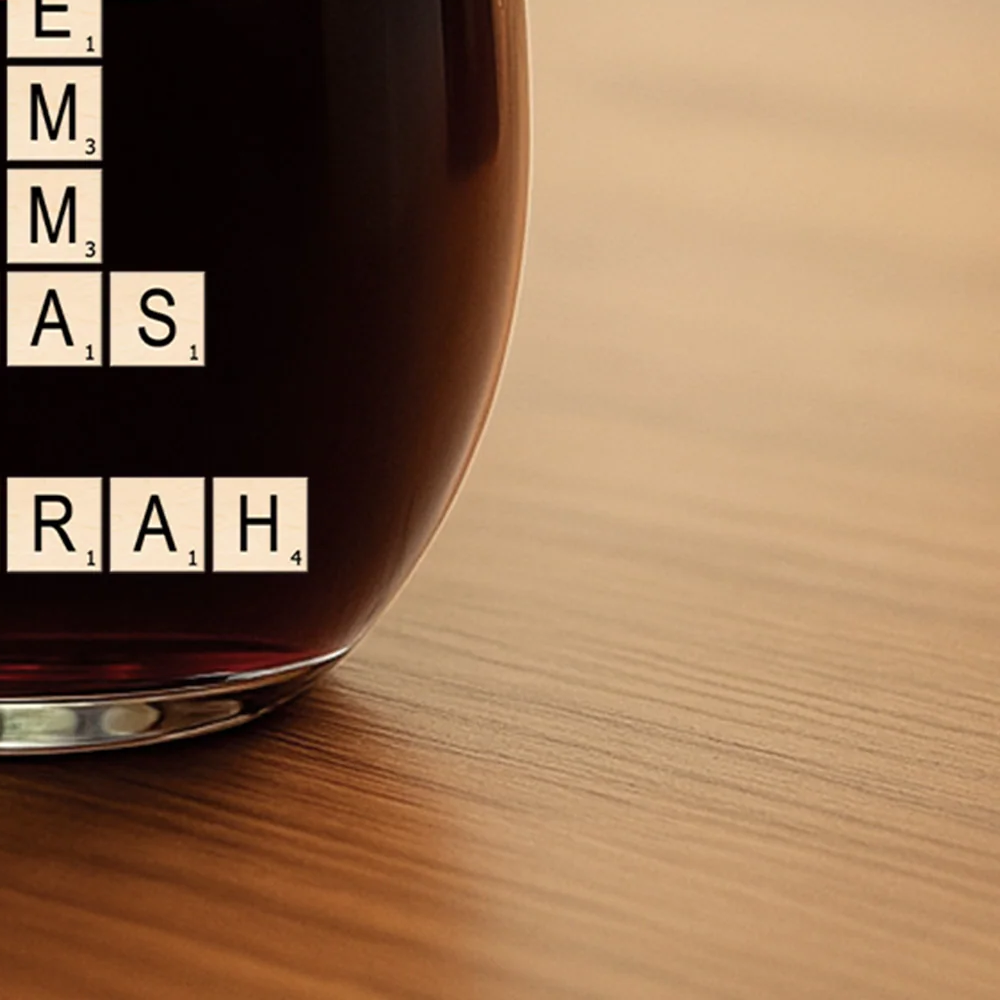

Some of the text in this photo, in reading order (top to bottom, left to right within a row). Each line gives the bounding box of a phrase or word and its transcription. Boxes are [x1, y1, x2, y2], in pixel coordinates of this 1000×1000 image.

[86, 36, 95, 52] 1
[85, 138, 96, 155] 3
[85, 240, 96, 258] 3
[85, 344, 94, 361] 1
[189, 344, 198, 361] 1
[86, 550, 96, 566] 1
[188, 550, 197, 566] 1
[290, 550, 302, 566] 4
